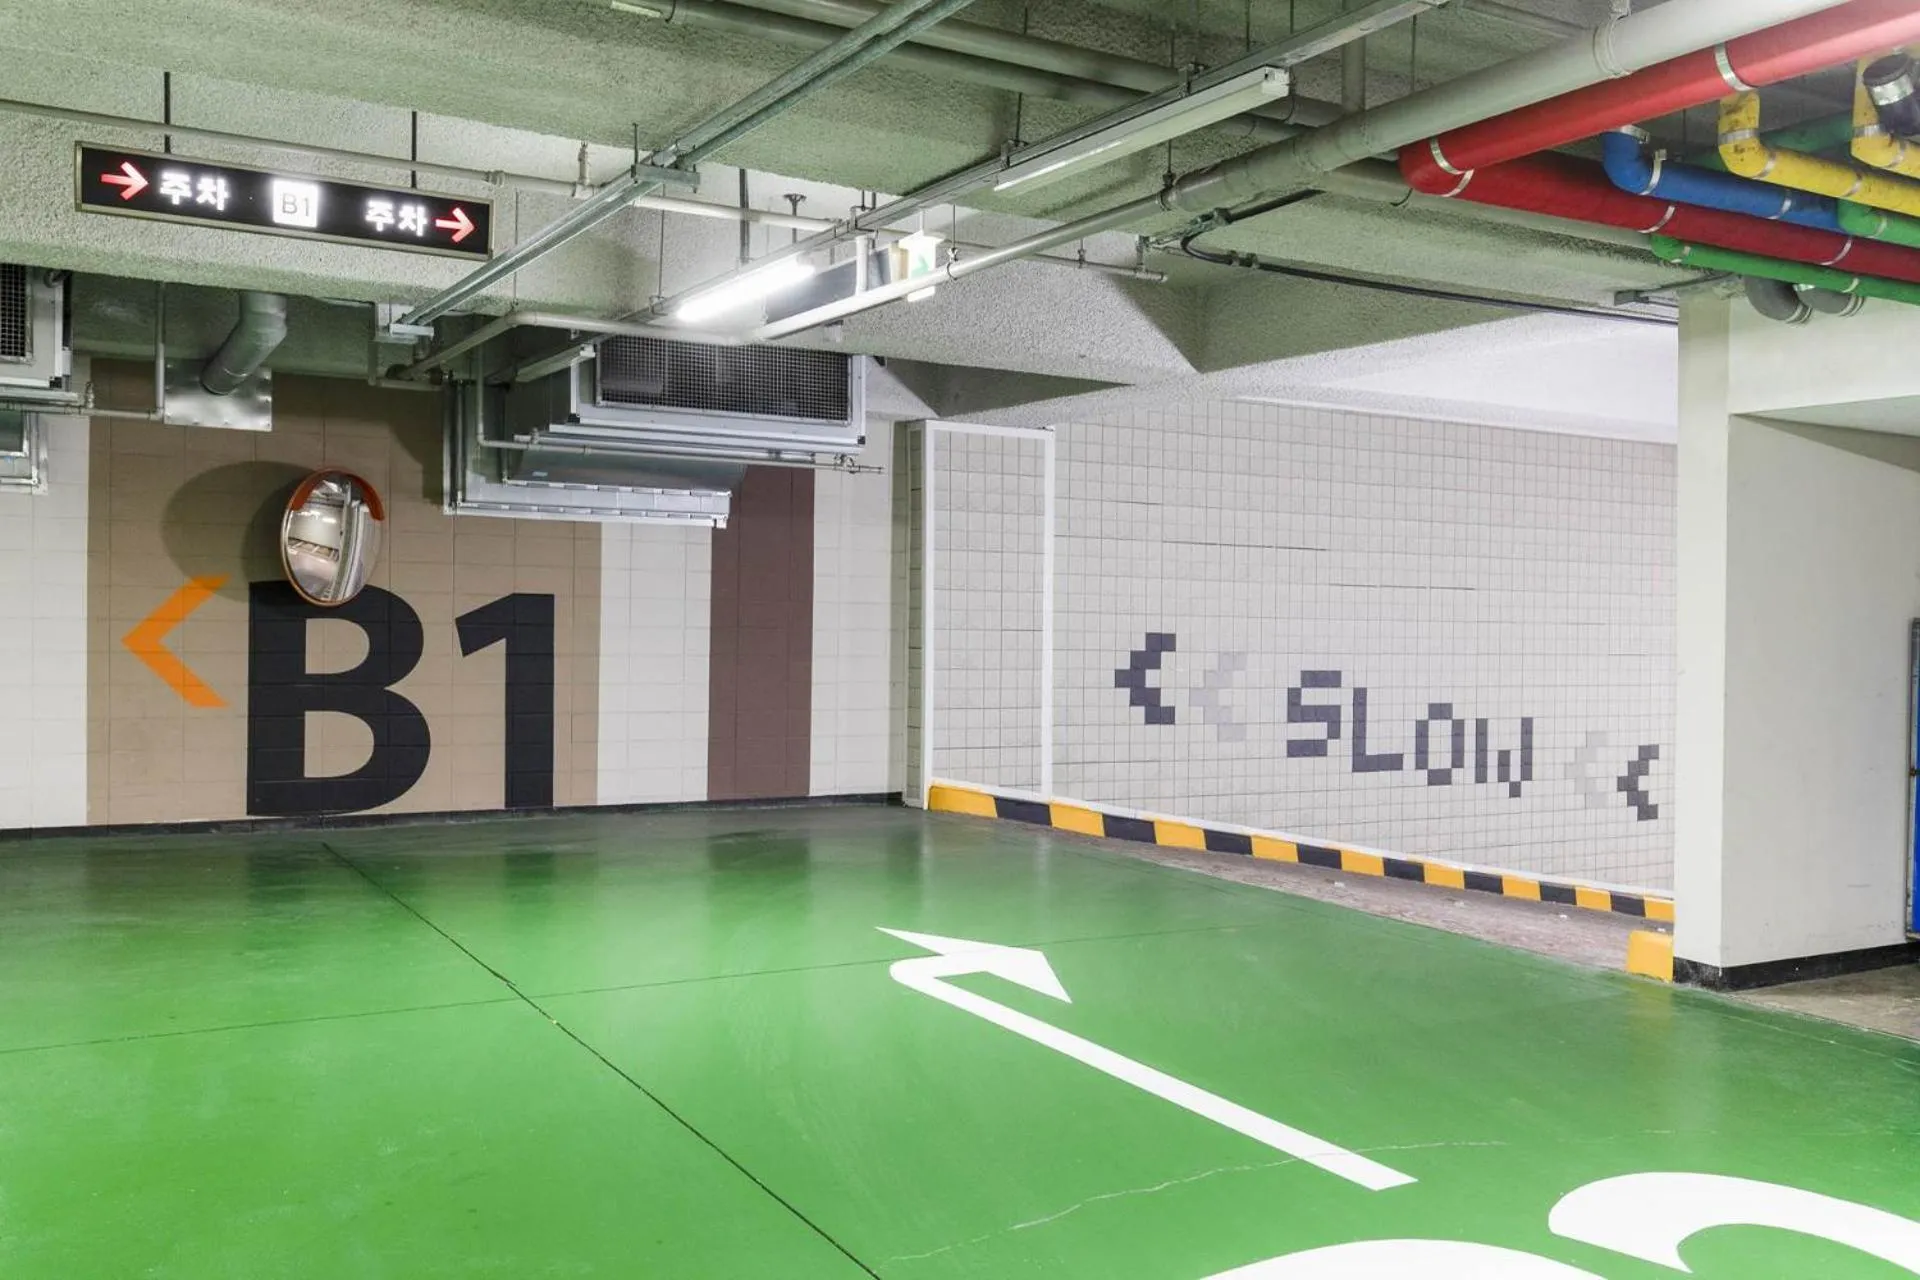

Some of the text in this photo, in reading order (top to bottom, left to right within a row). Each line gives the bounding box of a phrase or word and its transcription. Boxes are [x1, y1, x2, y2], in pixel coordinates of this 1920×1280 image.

[160, 171, 428, 237] 주차 B1 주차
[246, 580, 555, 817] B1
[1287, 670, 1533, 798] SLOW
